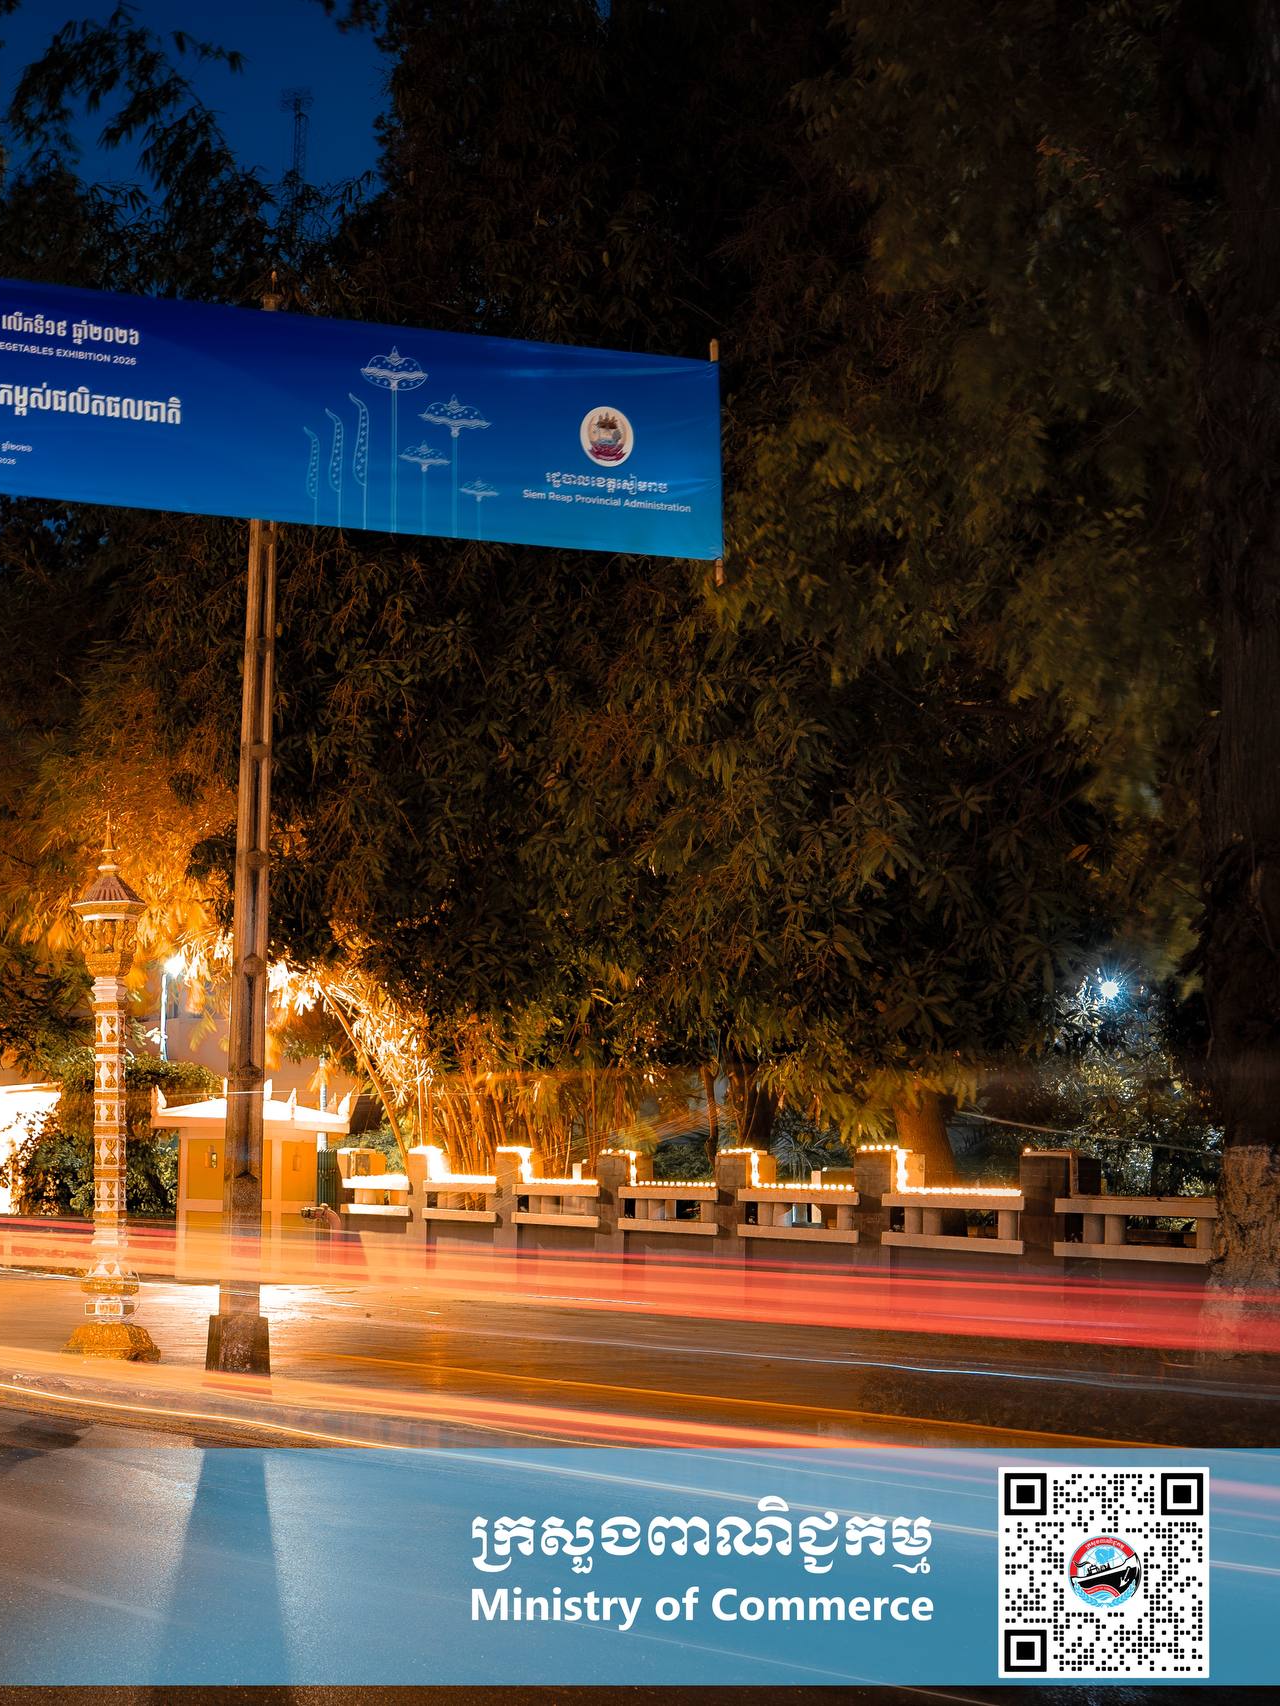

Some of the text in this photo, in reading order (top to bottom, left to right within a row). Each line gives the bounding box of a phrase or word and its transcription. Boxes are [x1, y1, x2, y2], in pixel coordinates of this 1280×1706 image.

[56, 348, 112, 363] EXHIBITION
[112, 355, 138, 366] 2026
[523, 489, 692, 513] Siem Reap Provincial Administration
